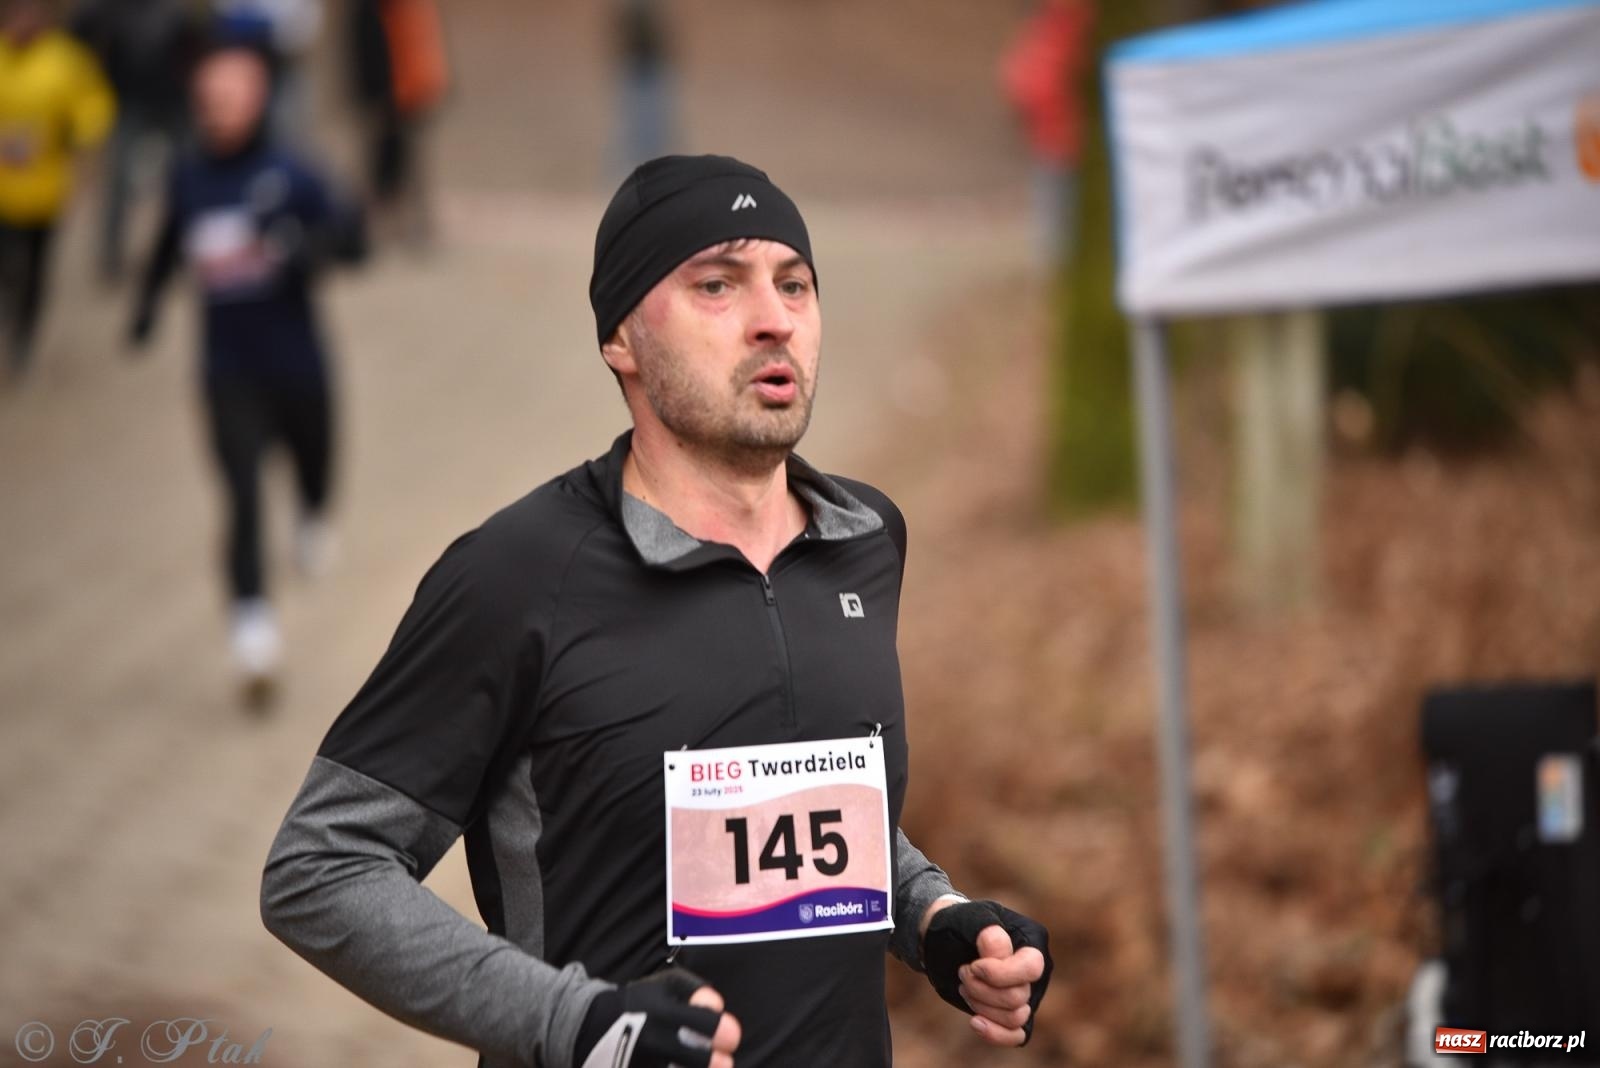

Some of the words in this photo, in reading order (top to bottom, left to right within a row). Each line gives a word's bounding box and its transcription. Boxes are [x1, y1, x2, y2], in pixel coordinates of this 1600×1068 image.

[690, 761, 742, 782] BIEG
[748, 751, 866, 777] Twardziela
[725, 809, 849, 884] 145
[815, 901, 864, 918] Racibórz
